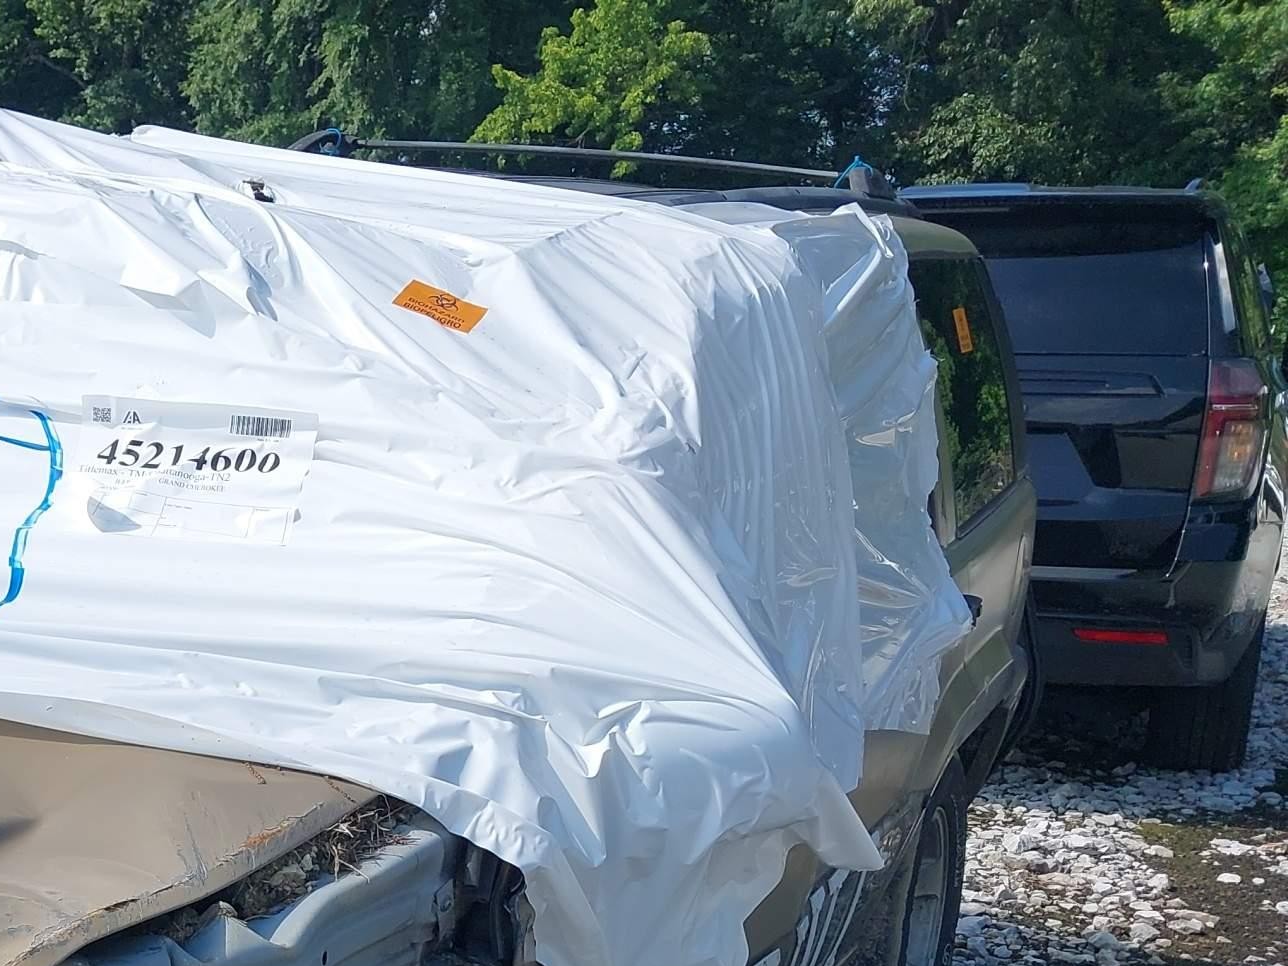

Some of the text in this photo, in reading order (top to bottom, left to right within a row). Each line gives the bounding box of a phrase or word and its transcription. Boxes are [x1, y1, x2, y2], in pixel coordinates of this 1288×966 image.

[403, 302, 462, 329] BIOPELIGRO
[407, 297, 465, 323] BIOHAZARD
[97, 438, 281, 474] 45214600
